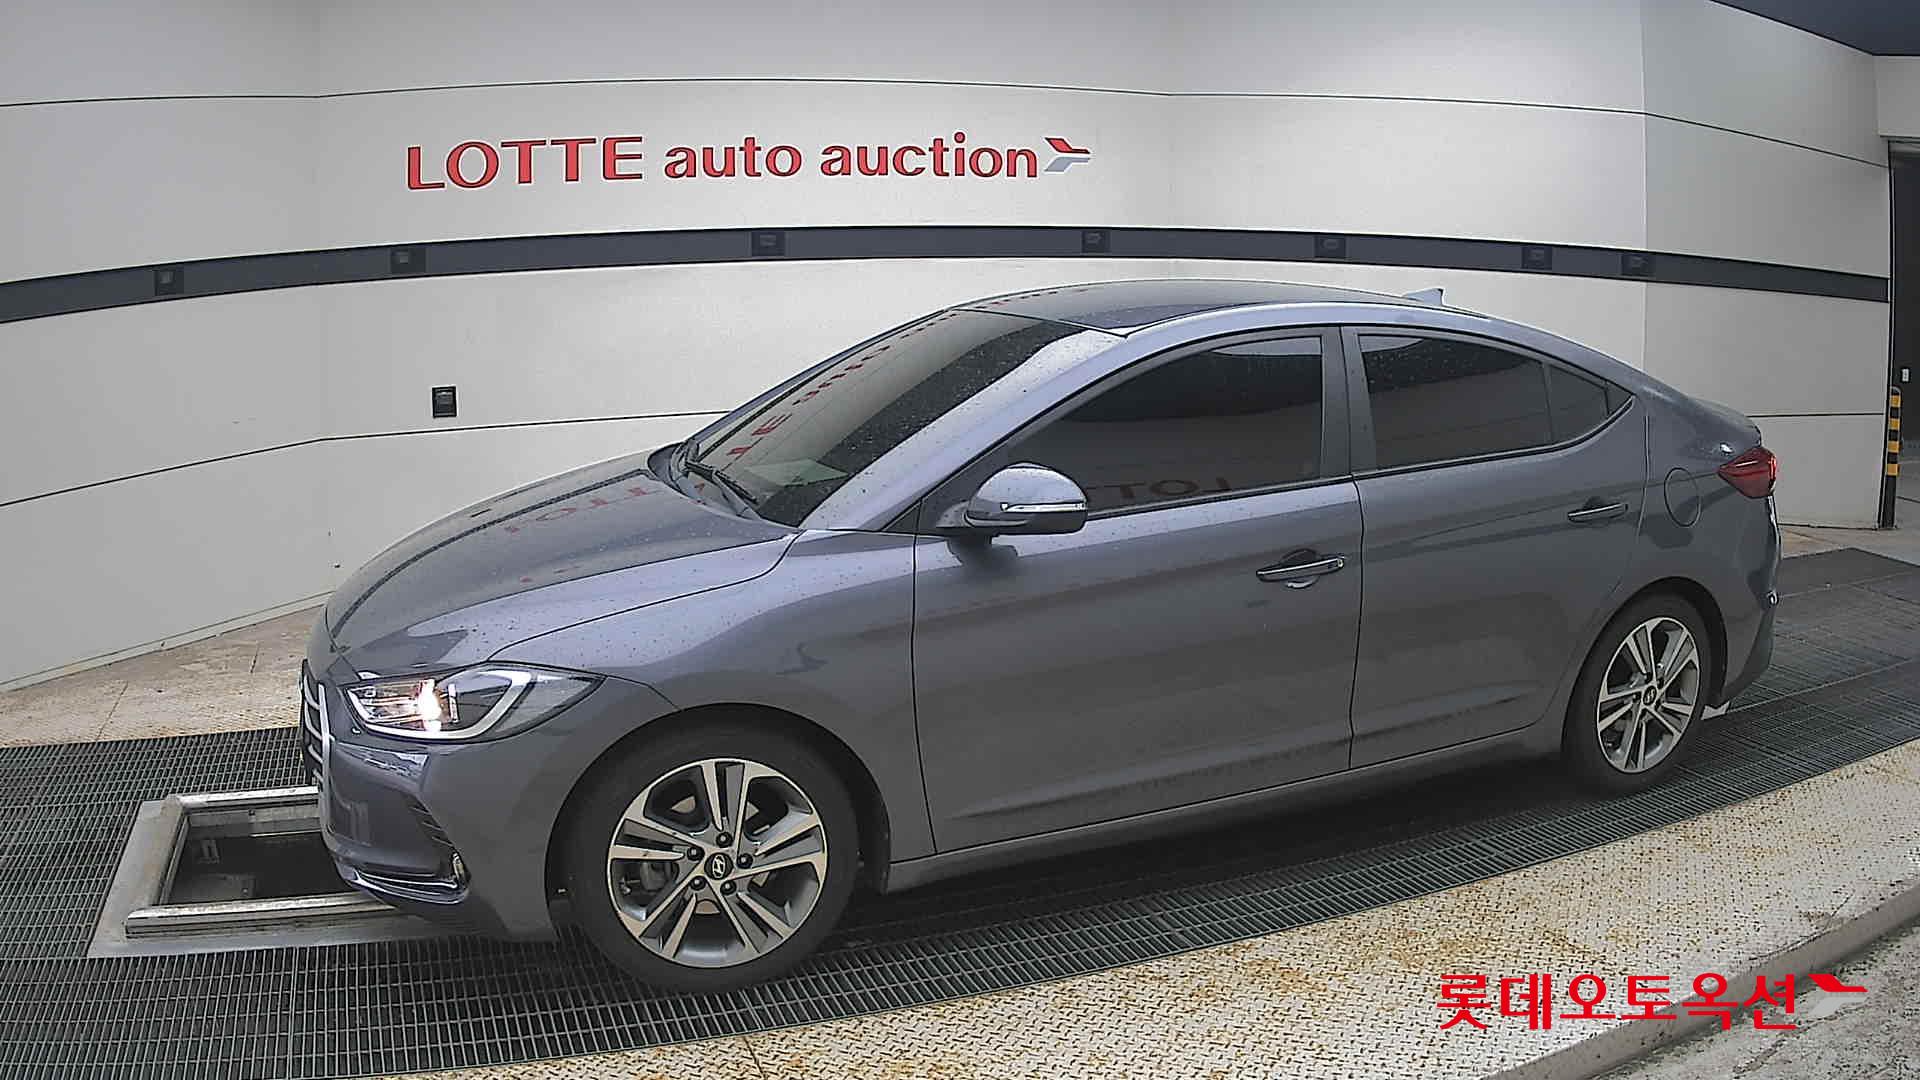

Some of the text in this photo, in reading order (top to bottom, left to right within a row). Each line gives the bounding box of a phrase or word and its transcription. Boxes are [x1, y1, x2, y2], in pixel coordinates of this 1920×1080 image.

[407, 131, 1039, 191] LOTTE auto auction
